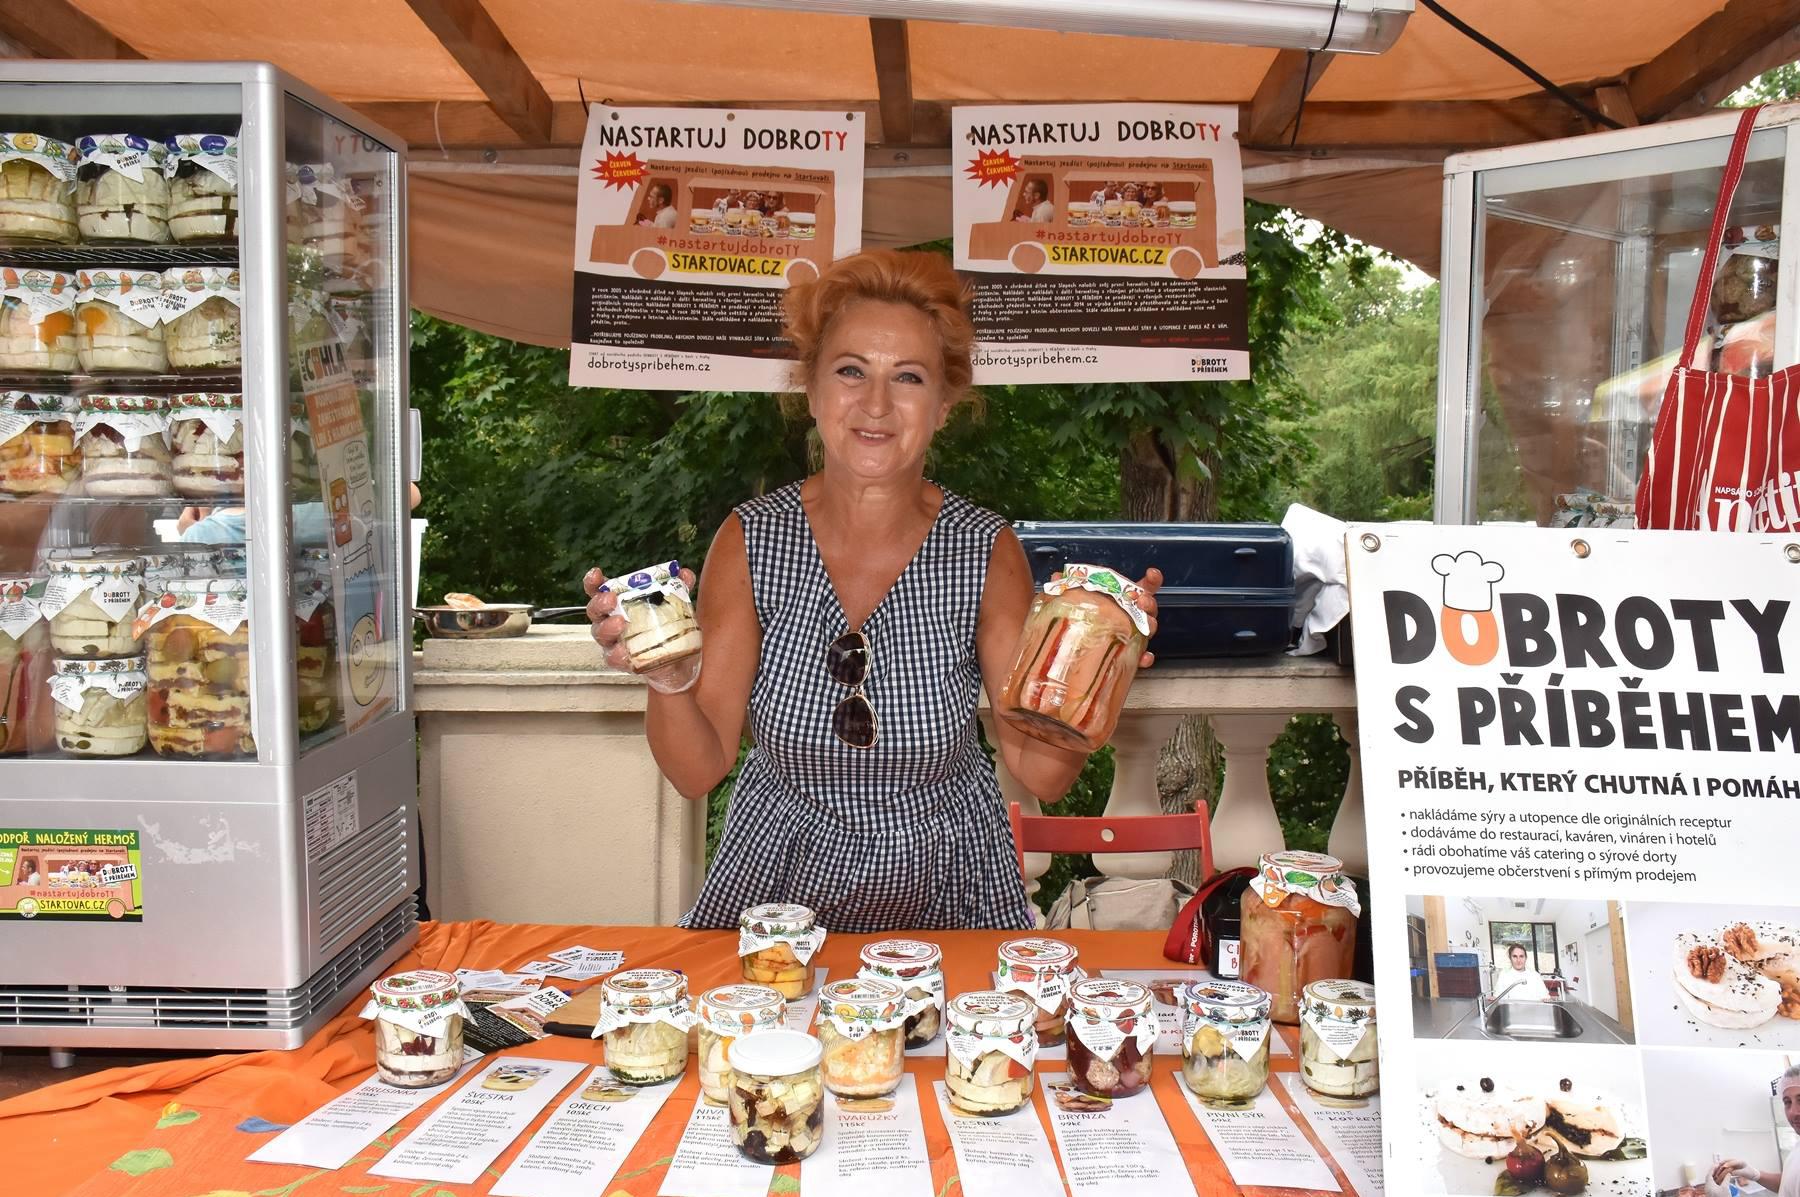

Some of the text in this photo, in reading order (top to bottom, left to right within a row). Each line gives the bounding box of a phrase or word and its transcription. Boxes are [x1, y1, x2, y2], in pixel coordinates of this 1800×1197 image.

[600, 125, 847, 151] NASTARTUJ DOBROTY
[970, 120, 1220, 146] NASTARTUJ DOBROTY
[672, 254, 781, 276] STARTOVAC.CZ
[1052, 246, 1163, 265] STARTOVAC.CZ
[587, 357, 710, 373] dobrotyspribehem.cz
[972, 352, 1098, 368] dobrotyspribehem.cz
[1192, 358, 1227, 367] DOBROTY
[1383, 590, 1790, 674] DOBROTY
[1393, 673, 1800, 753] S PŘÍBĚHEM
[1398, 766, 1494, 793] PŘÍBĚH,
[1500, 770, 1578, 792] KTERÝ
[1584, 773, 1688, 796] CHUTNÁ
[1693, 777, 1701, 796] I
[1409, 808, 1732, 830] nakládáme sýry a utopence dle originálních receptur
[36, 832, 88, 844] NALOŽENÝ
[95, 832, 135, 844] HERMOŠ
[1410, 826, 1717, 846] dodáváme do restaurací, kaváren, vináren i hotelů
[1412, 845, 1677, 865] rádi obohatíme váš catering o sýrové dorty
[102, 865, 133, 876] DOBROTY
[1413, 864, 1696, 884] provozujeme občerstvení s přímým prodejem
[41, 900, 104, 910] STARTOVAC.CZ
[465, 1091, 513, 1101] ŠVESTKA
[569, 1102, 611, 1111] OŘECH
